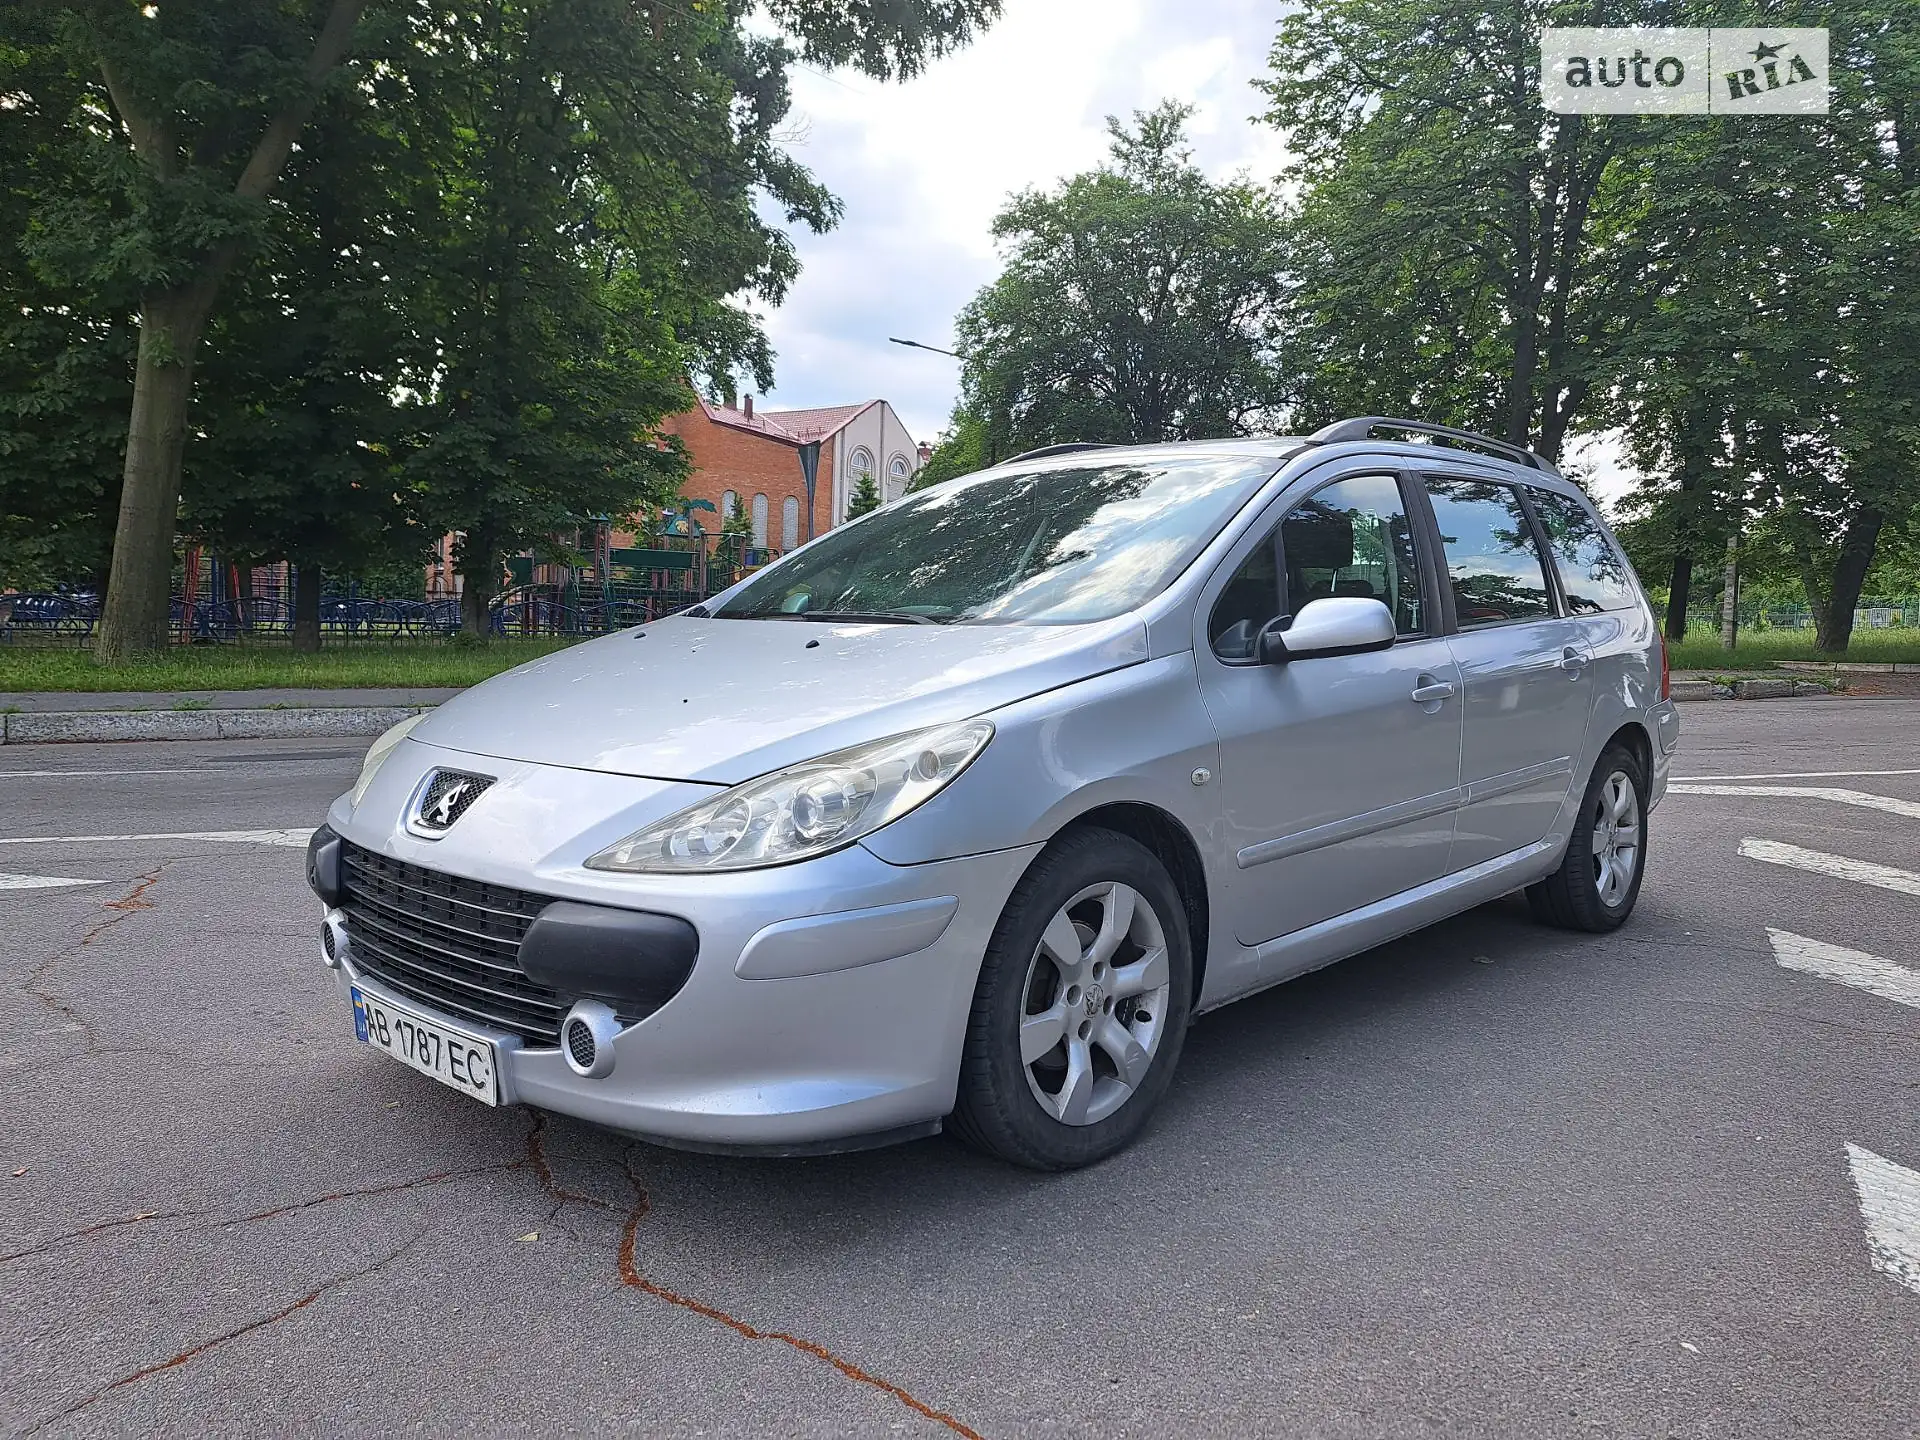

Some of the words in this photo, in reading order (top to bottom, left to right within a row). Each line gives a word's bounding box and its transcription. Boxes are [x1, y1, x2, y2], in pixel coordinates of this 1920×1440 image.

[364, 1002, 392, 1047] AB
[395, 1018, 441, 1072] 1787
[447, 1040, 486, 1090] EC
